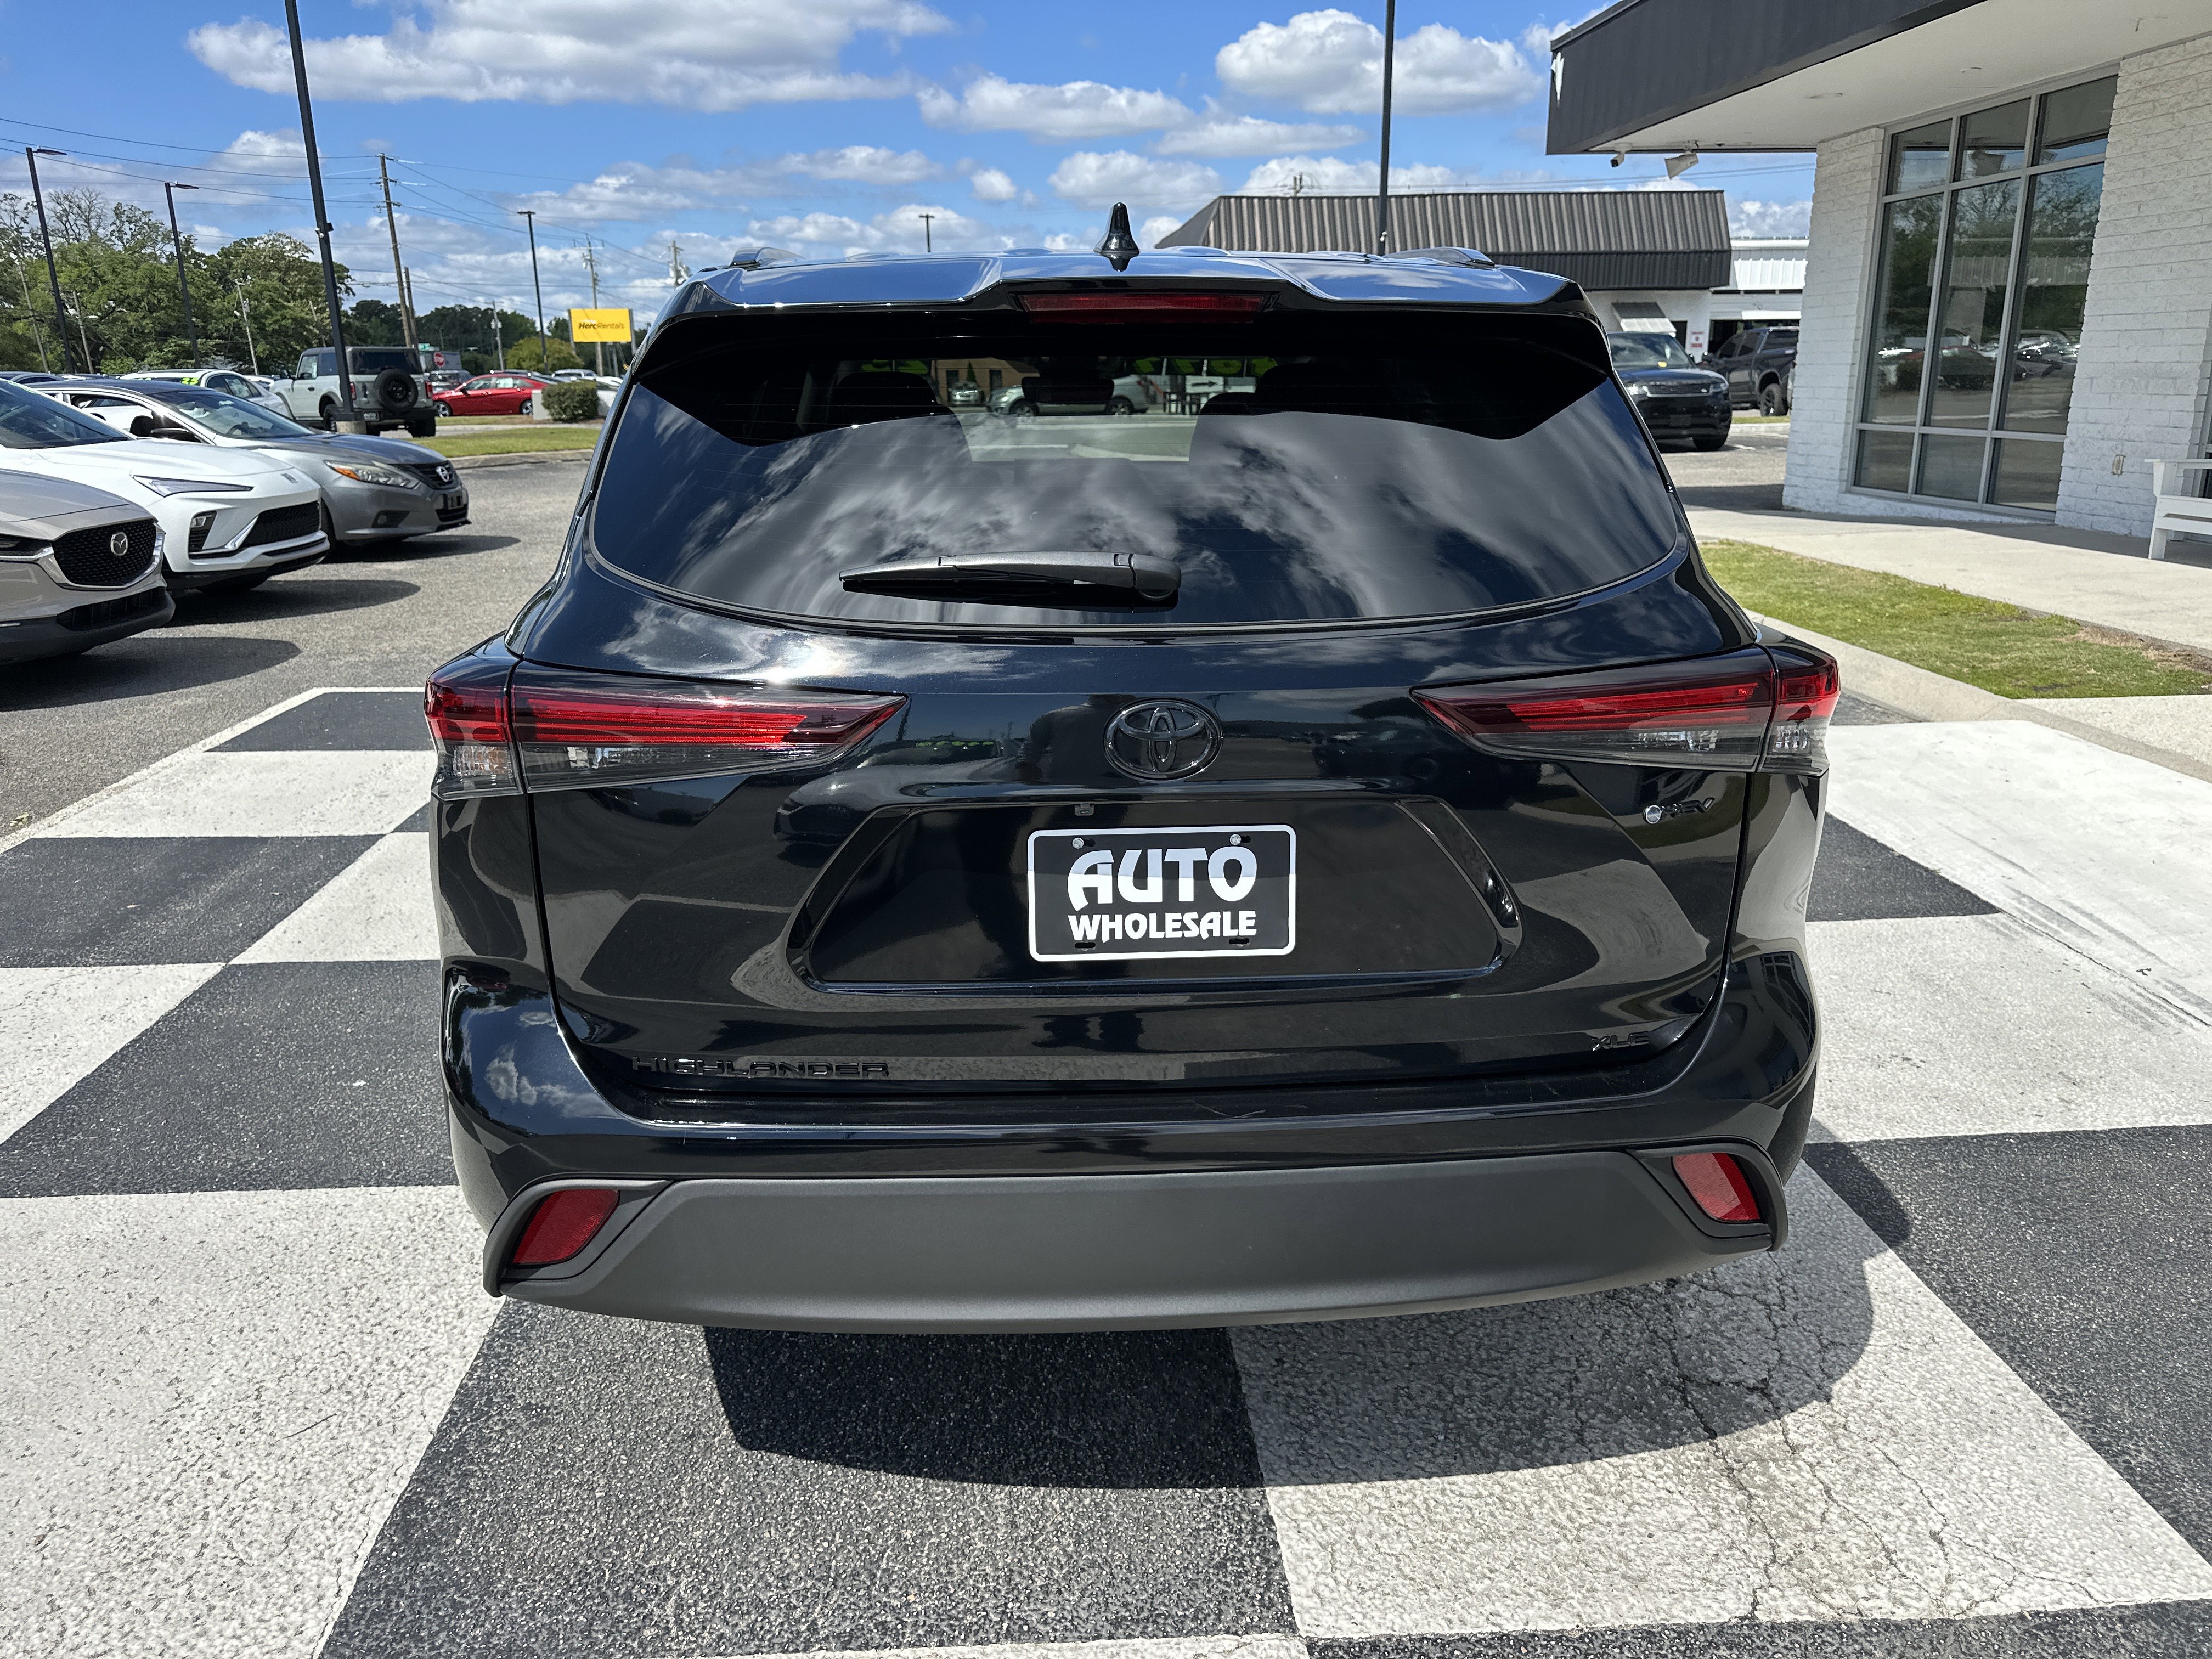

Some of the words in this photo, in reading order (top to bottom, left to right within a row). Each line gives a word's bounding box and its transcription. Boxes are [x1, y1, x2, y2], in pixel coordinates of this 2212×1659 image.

[1067, 845, 1257, 911] AUTO
[1068, 910, 1257, 943] WHOLESALE
[1591, 1031, 1650, 1052] XLE
[632, 1055, 889, 1079] HIGHLANDER
